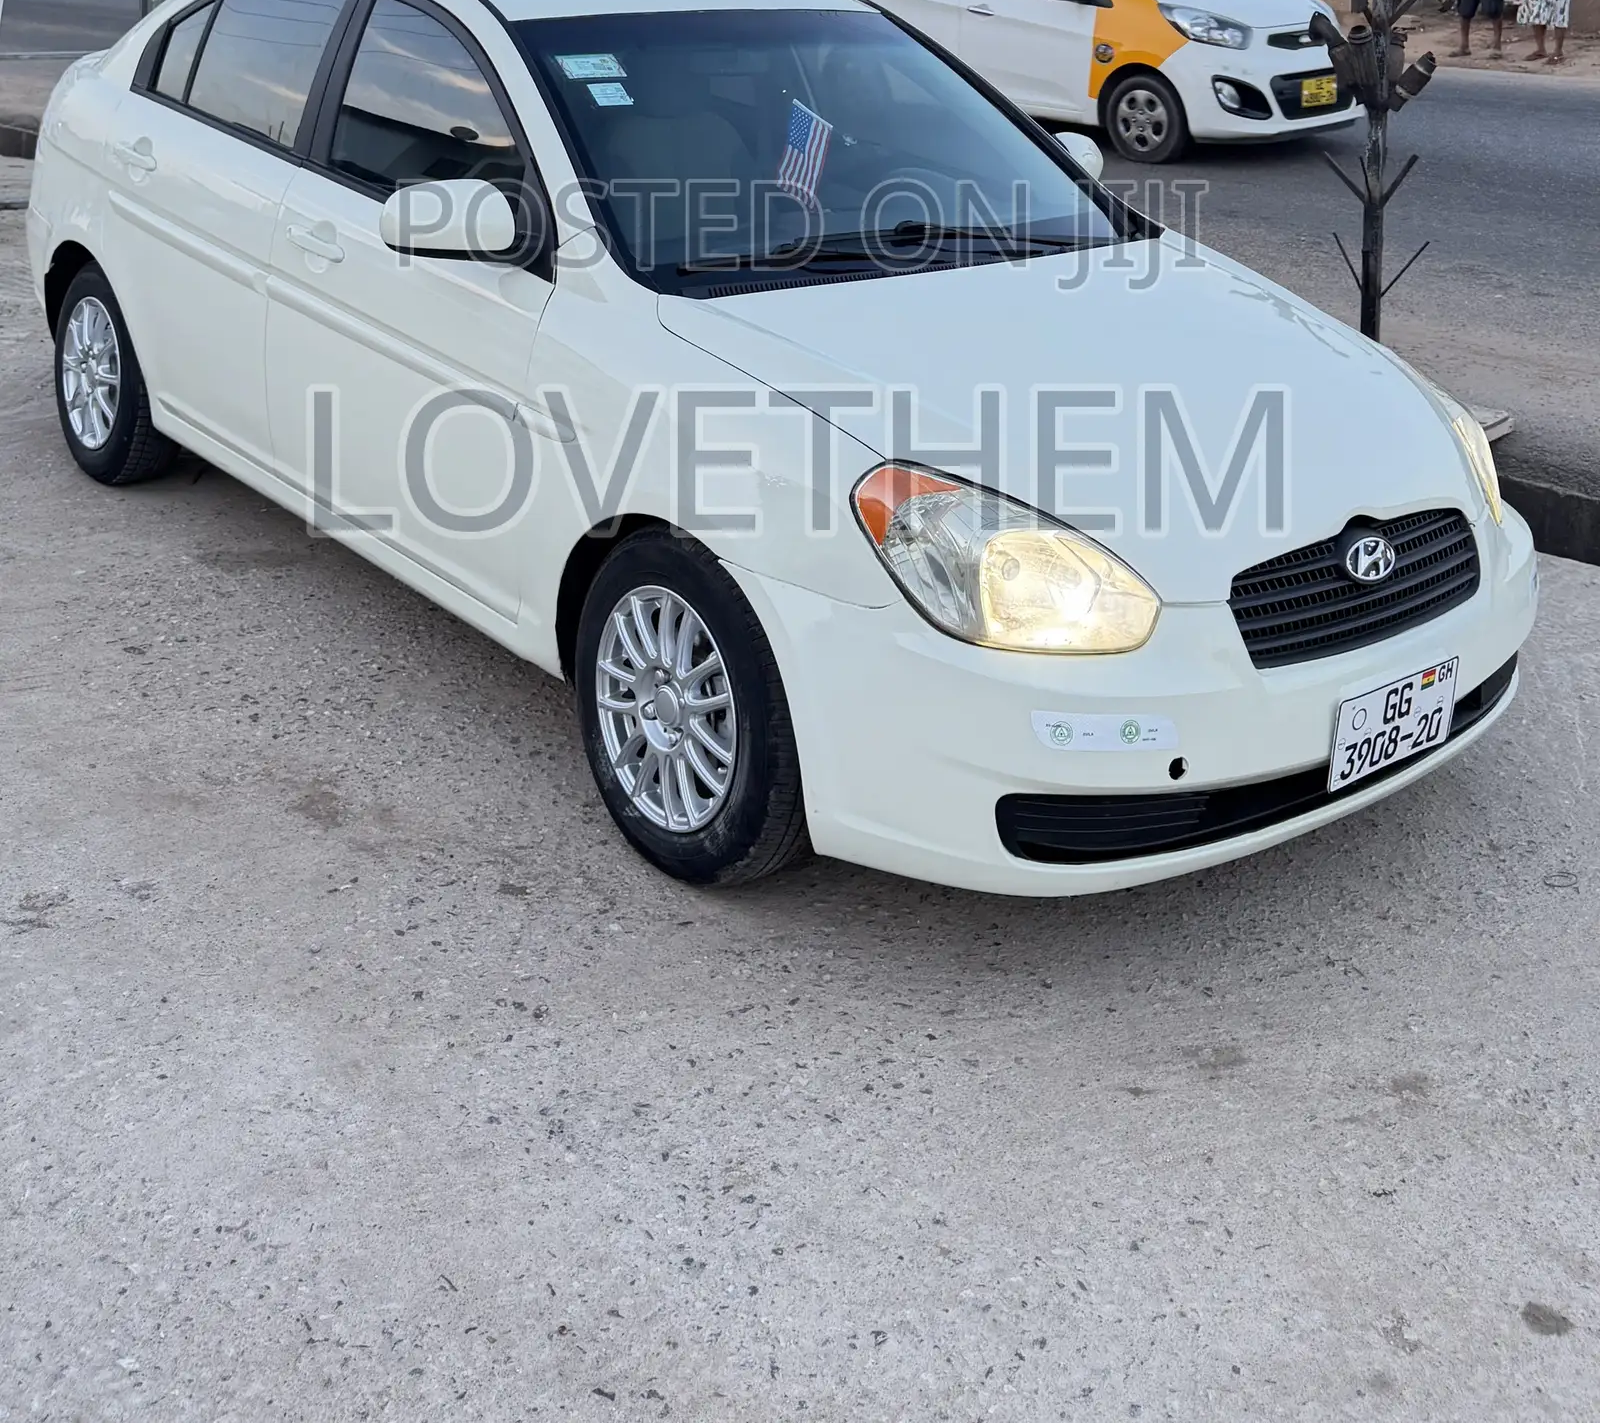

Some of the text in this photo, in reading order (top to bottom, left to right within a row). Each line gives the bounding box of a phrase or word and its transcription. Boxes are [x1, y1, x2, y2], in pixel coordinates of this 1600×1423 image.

[1438, 660, 1455, 683] GH
[1382, 681, 1414, 725] GG
[1340, 707, 1443, 780] 3908-20
